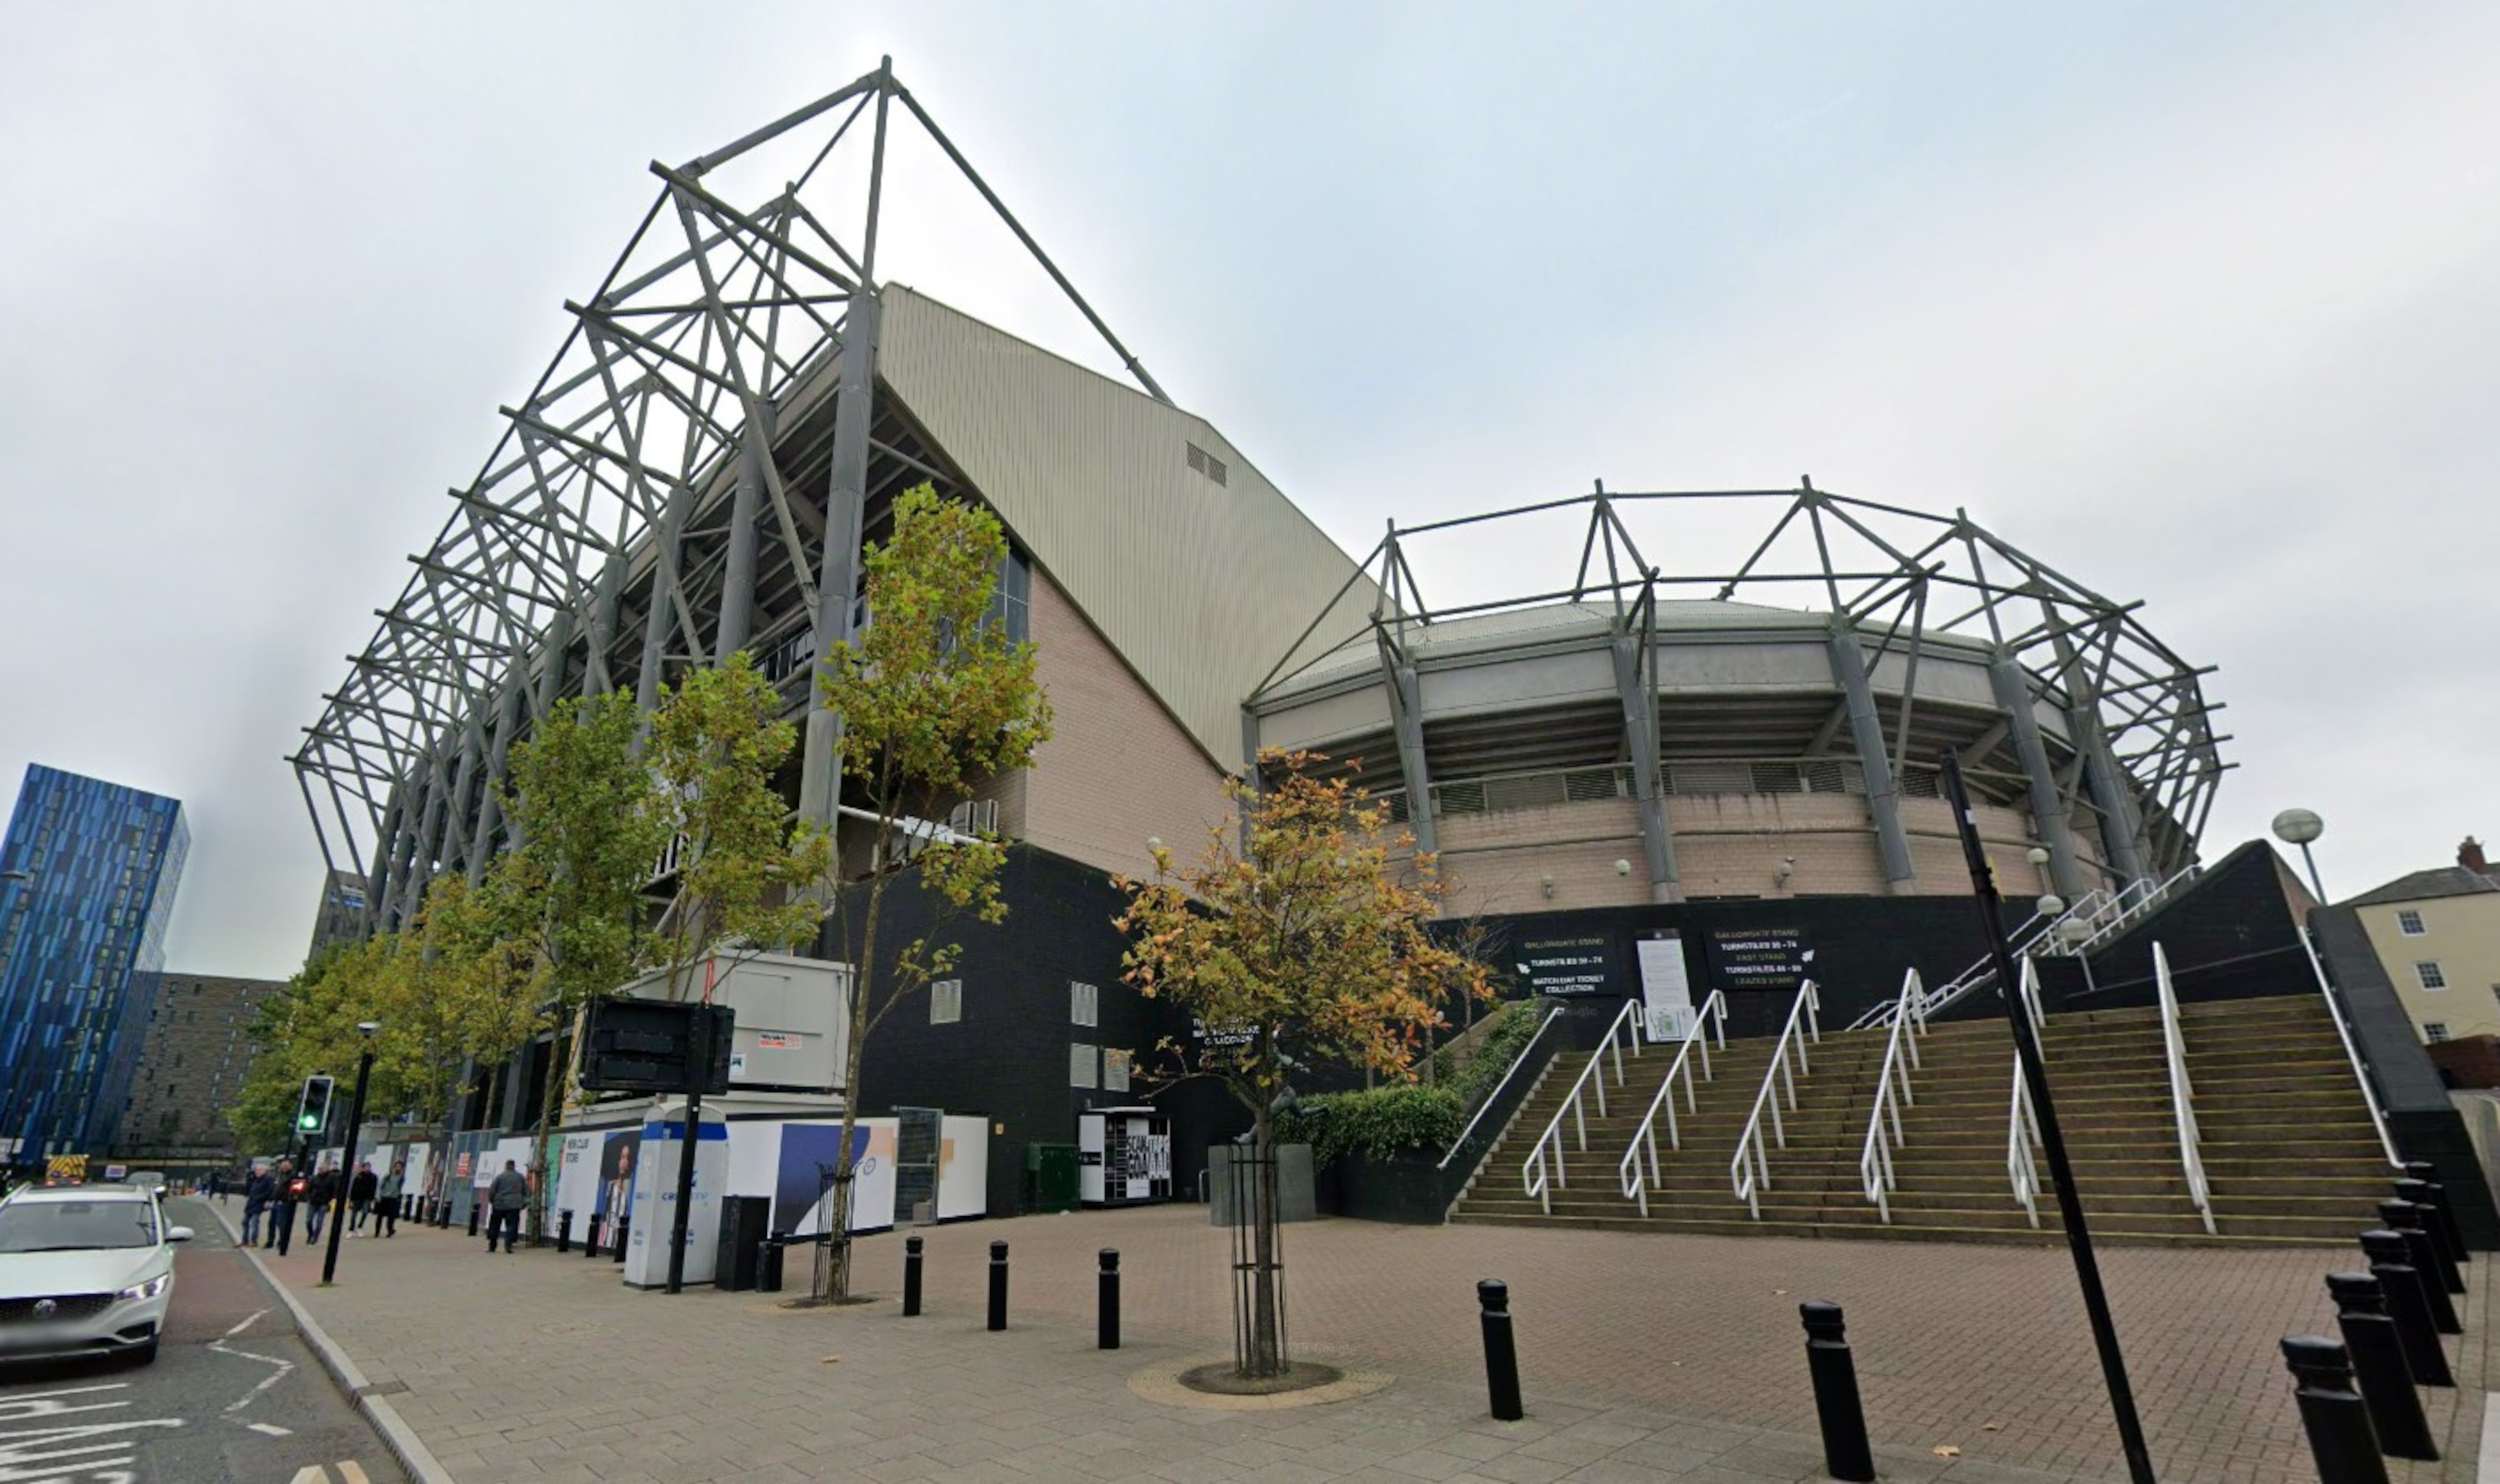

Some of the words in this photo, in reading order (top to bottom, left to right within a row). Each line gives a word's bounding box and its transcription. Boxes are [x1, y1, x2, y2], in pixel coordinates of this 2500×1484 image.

[1720, 942, 1770, 951] TURNSTILES
[1531, 958, 1577, 967] TURNSTILES
[1725, 964, 1775, 974] TURNSTILES
[1532, 976, 1559, 985] MATCH
[1576, 974, 1604, 984] TICKET
[1545, 984, 1596, 993] COLLECTION
